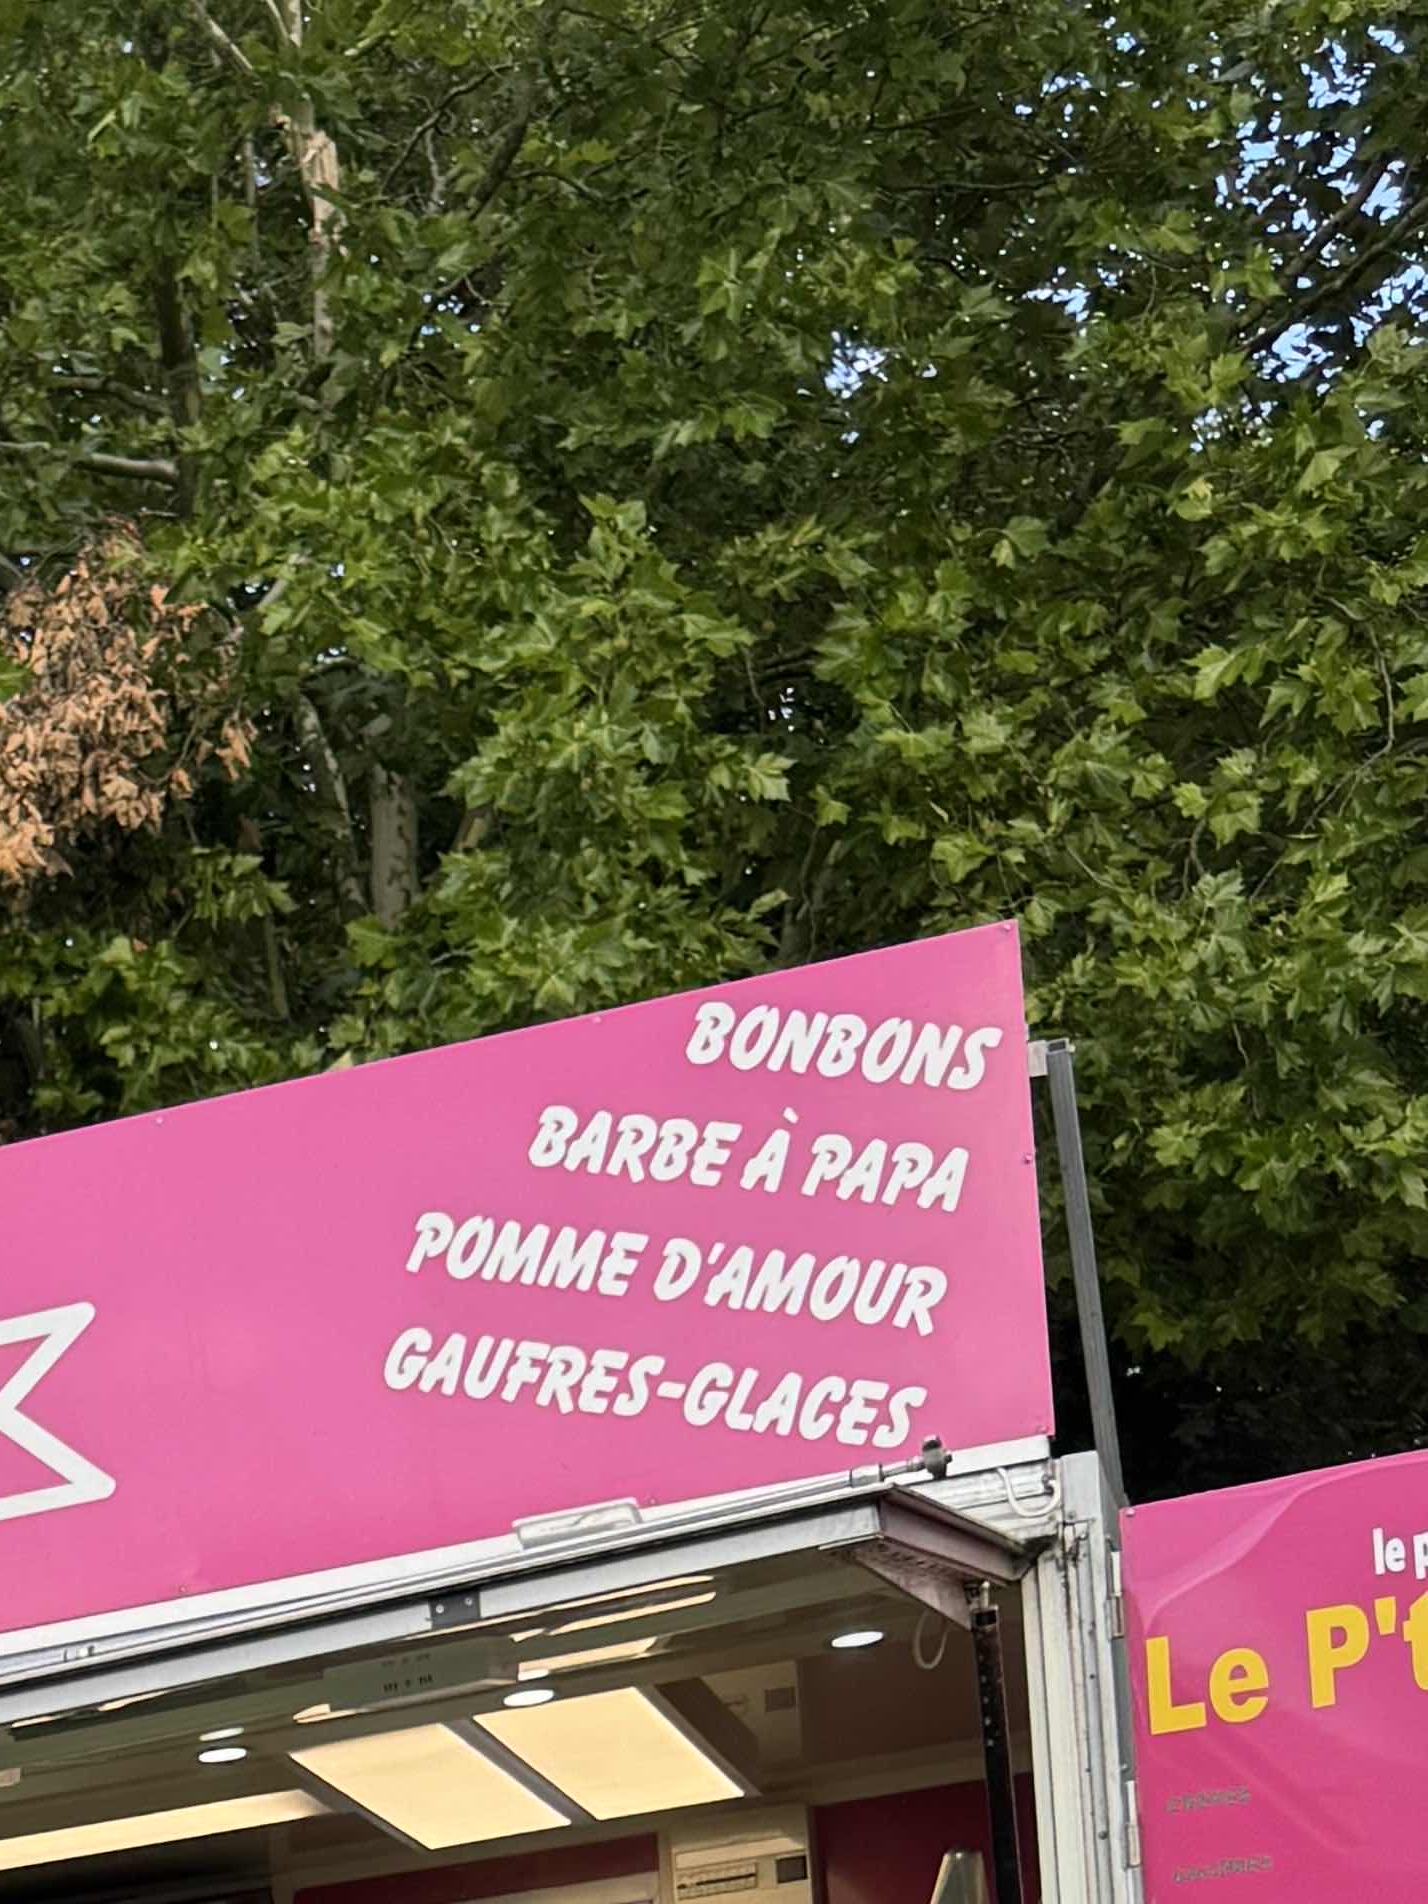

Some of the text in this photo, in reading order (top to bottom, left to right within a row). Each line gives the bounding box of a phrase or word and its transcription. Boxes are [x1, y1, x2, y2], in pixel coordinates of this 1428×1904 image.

[685, 1000, 1001, 1091] BONBONS
[528, 1104, 969, 1212] BARBE À PAPA
[405, 1212, 947, 1337] POMME D'AMOUR
[383, 1327, 928, 1449] GAUFRES-GLACES
[1373, 1528, 1406, 1575] le
[1146, 1636, 1269, 1735] Le
